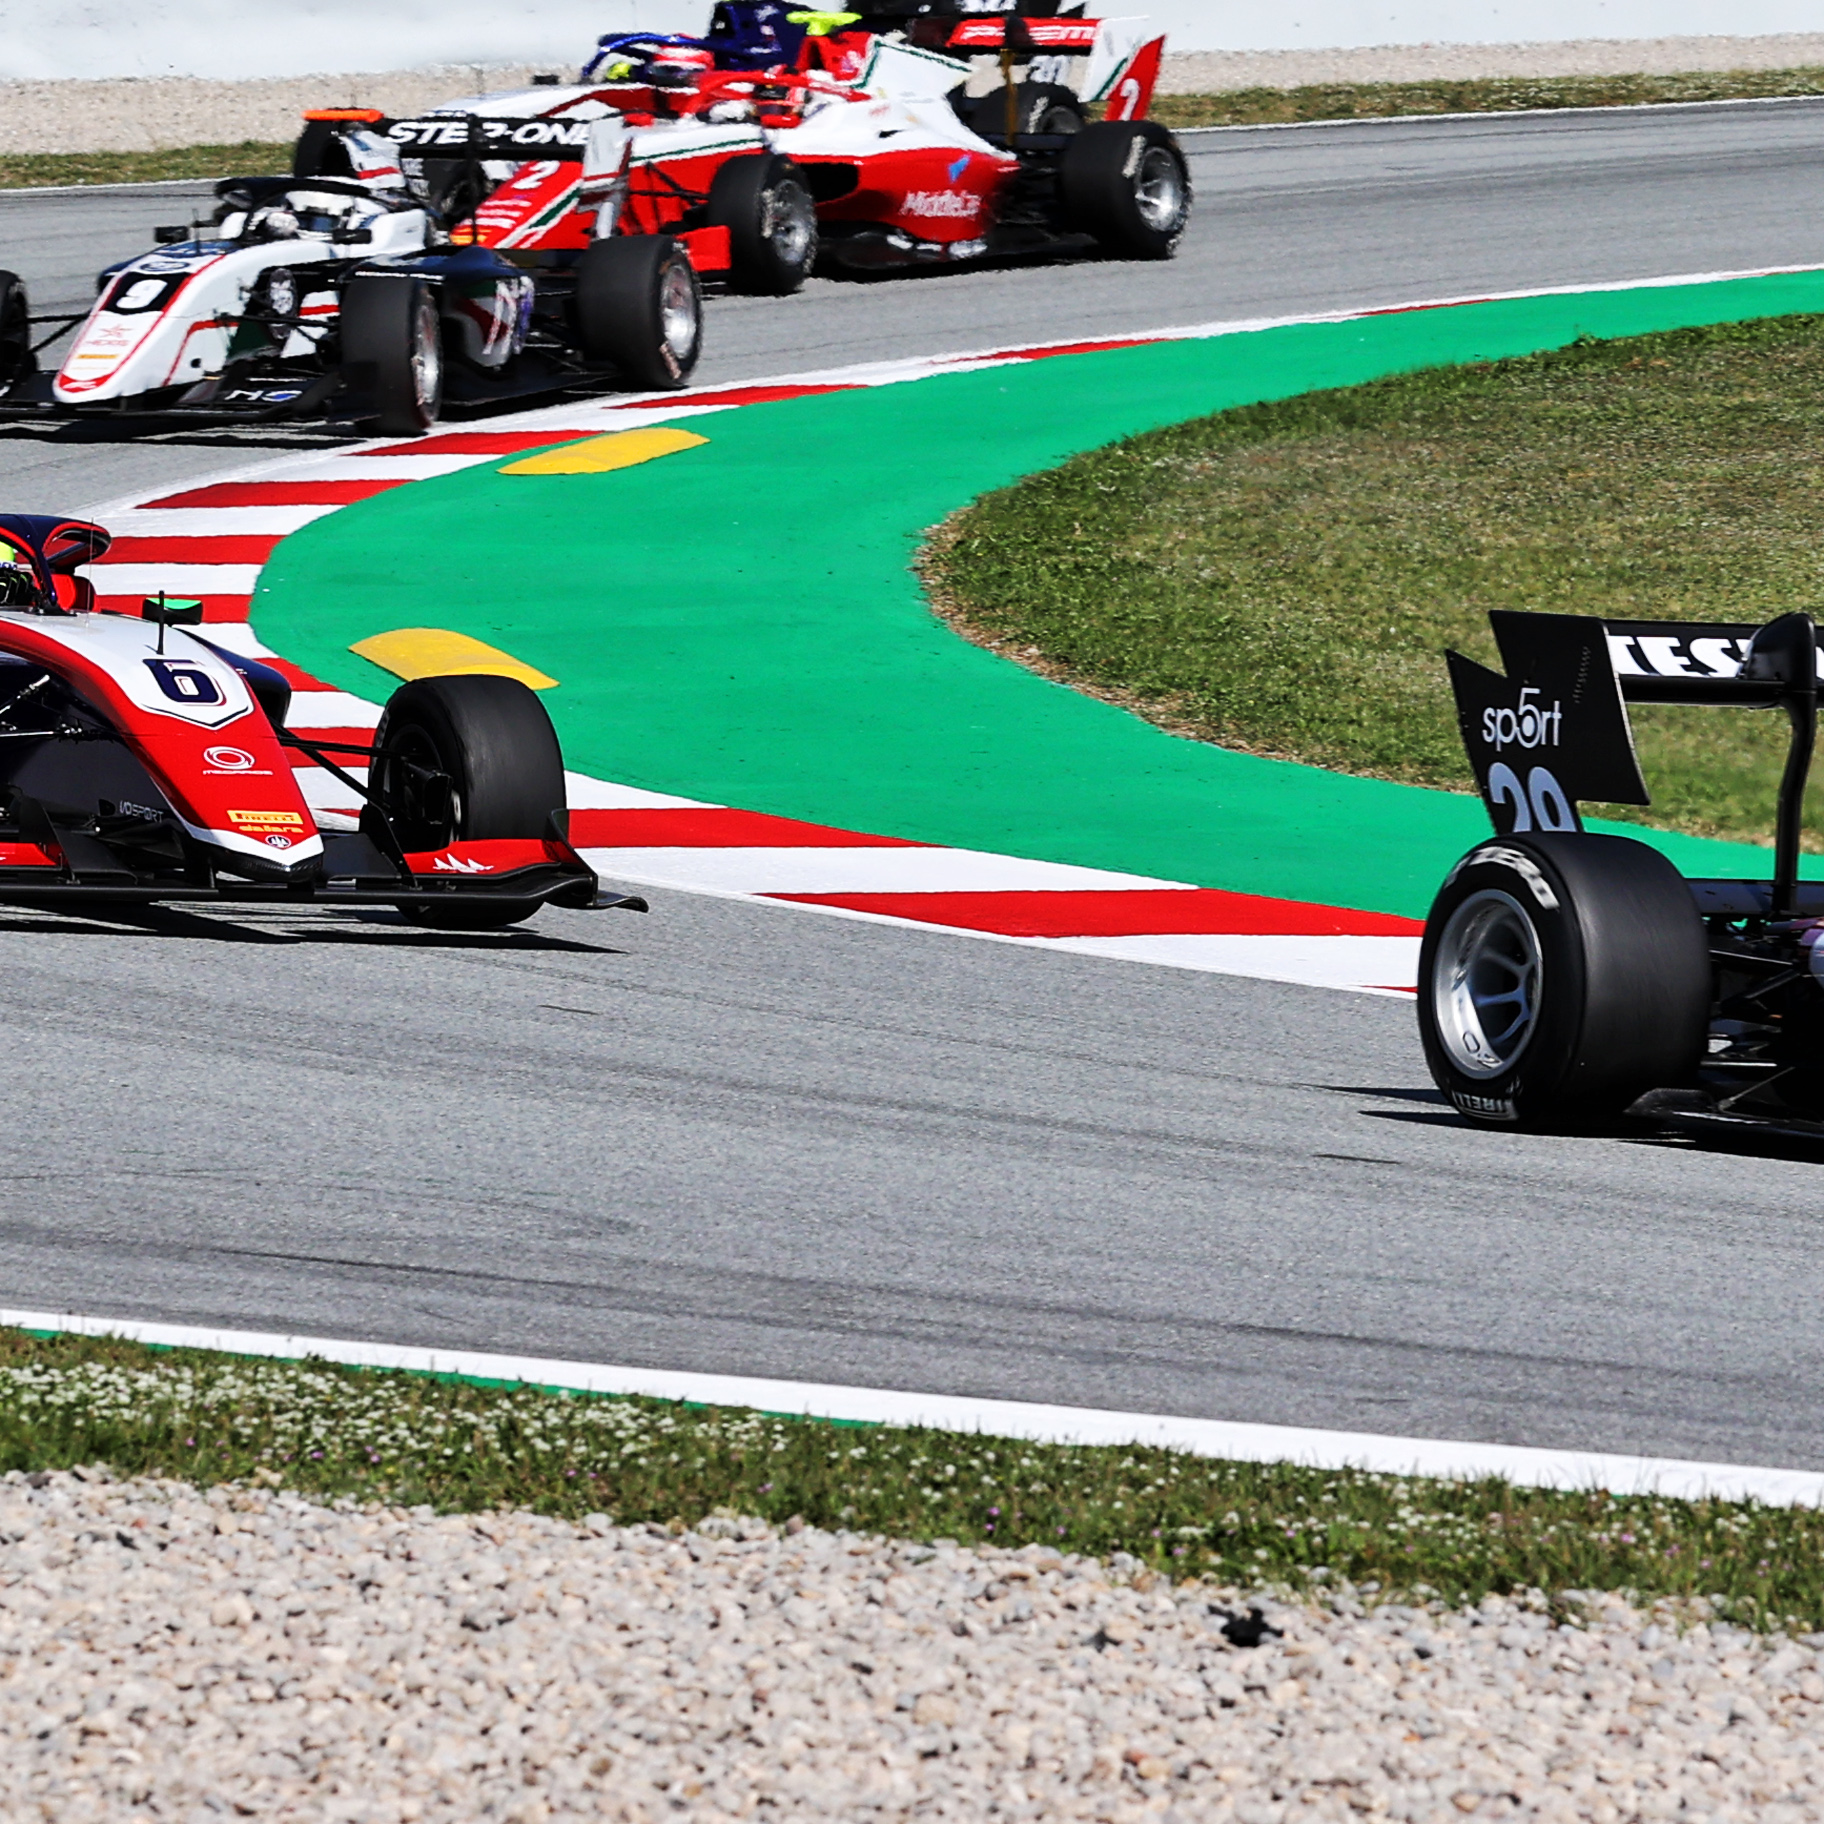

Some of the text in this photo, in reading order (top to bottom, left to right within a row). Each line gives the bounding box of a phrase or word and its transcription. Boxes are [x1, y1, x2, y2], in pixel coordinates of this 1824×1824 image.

[511, 160, 561, 190] 2
[115, 278, 169, 310] 9
[142, 658, 227, 707] 6
